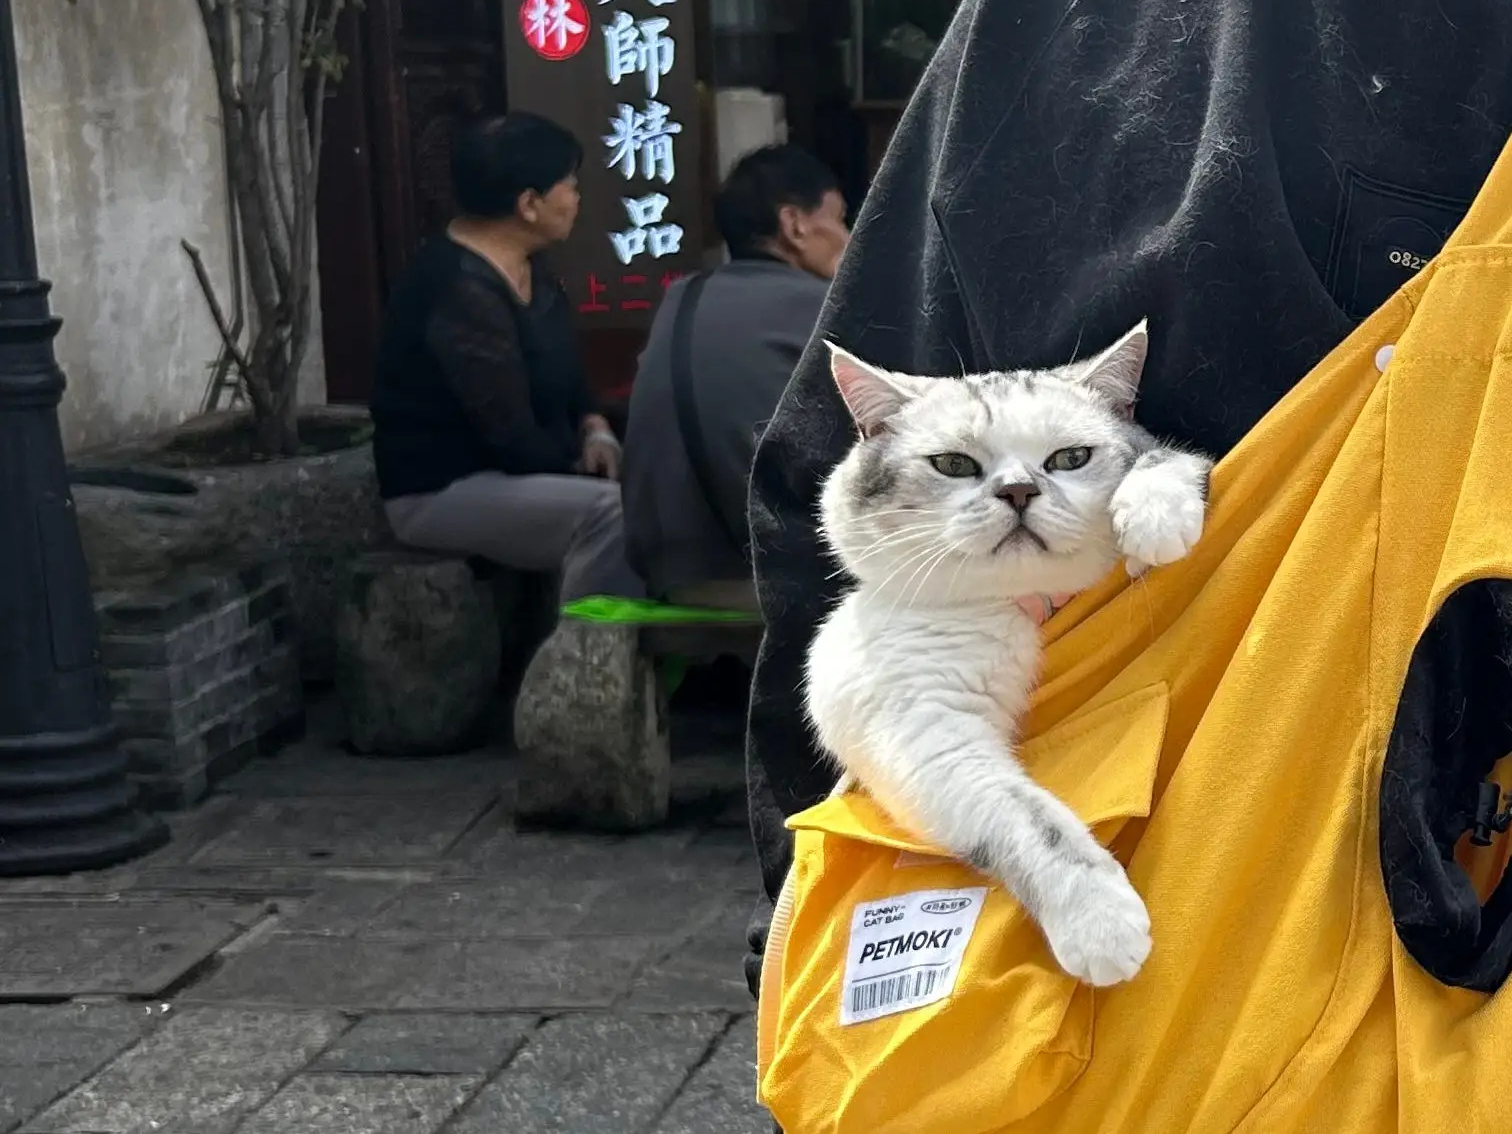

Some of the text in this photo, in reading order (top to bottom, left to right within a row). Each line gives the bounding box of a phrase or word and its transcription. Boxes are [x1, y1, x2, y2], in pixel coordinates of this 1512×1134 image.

[578, 270, 686, 312] 上二
[863, 912, 905, 927] CAT BAG
